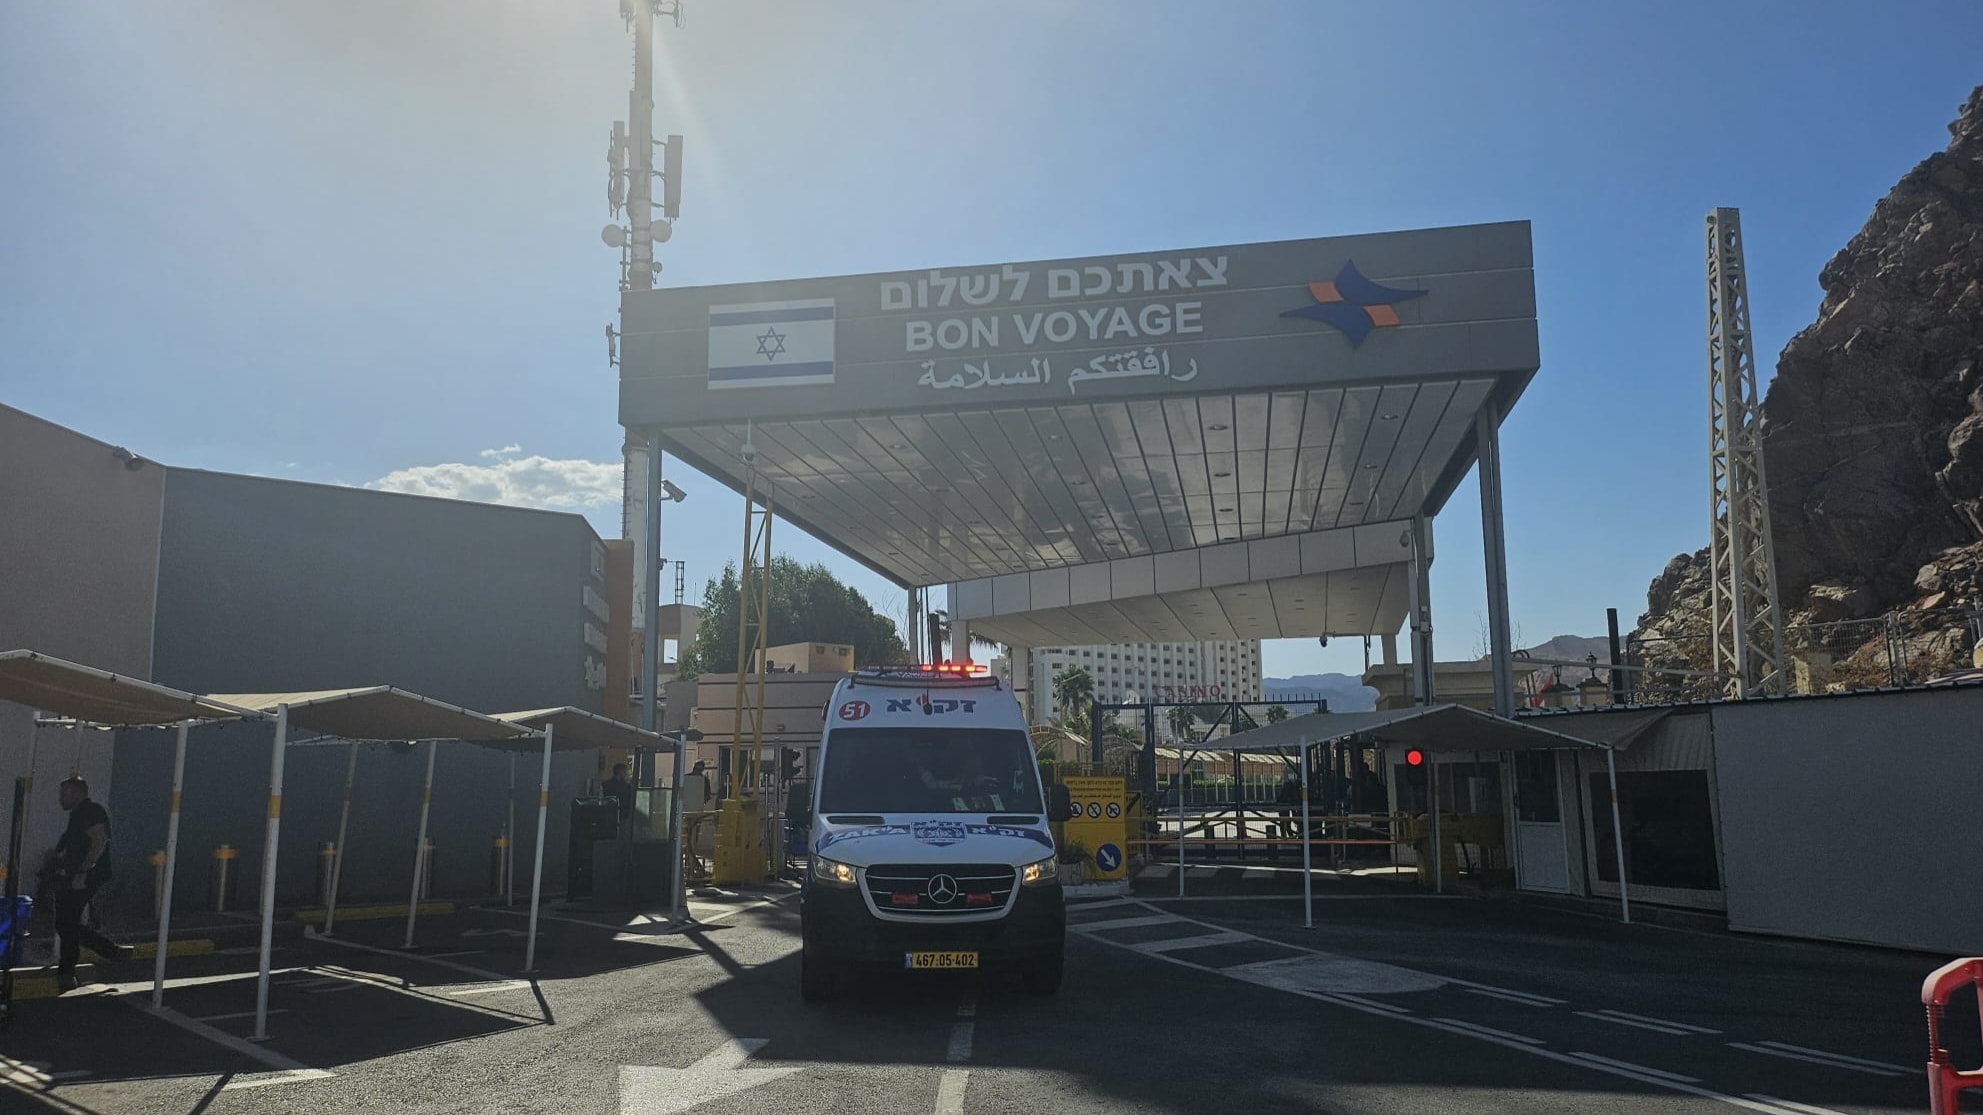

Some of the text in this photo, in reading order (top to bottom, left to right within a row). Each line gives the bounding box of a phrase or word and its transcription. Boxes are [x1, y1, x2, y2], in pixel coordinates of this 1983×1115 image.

[880, 255, 1228, 311] צאתכם לשלום
[906, 301, 1204, 352] BON VOYAGE
[917, 346, 1198, 395] رافقتكم السلامة
[844, 703, 866, 719] 51
